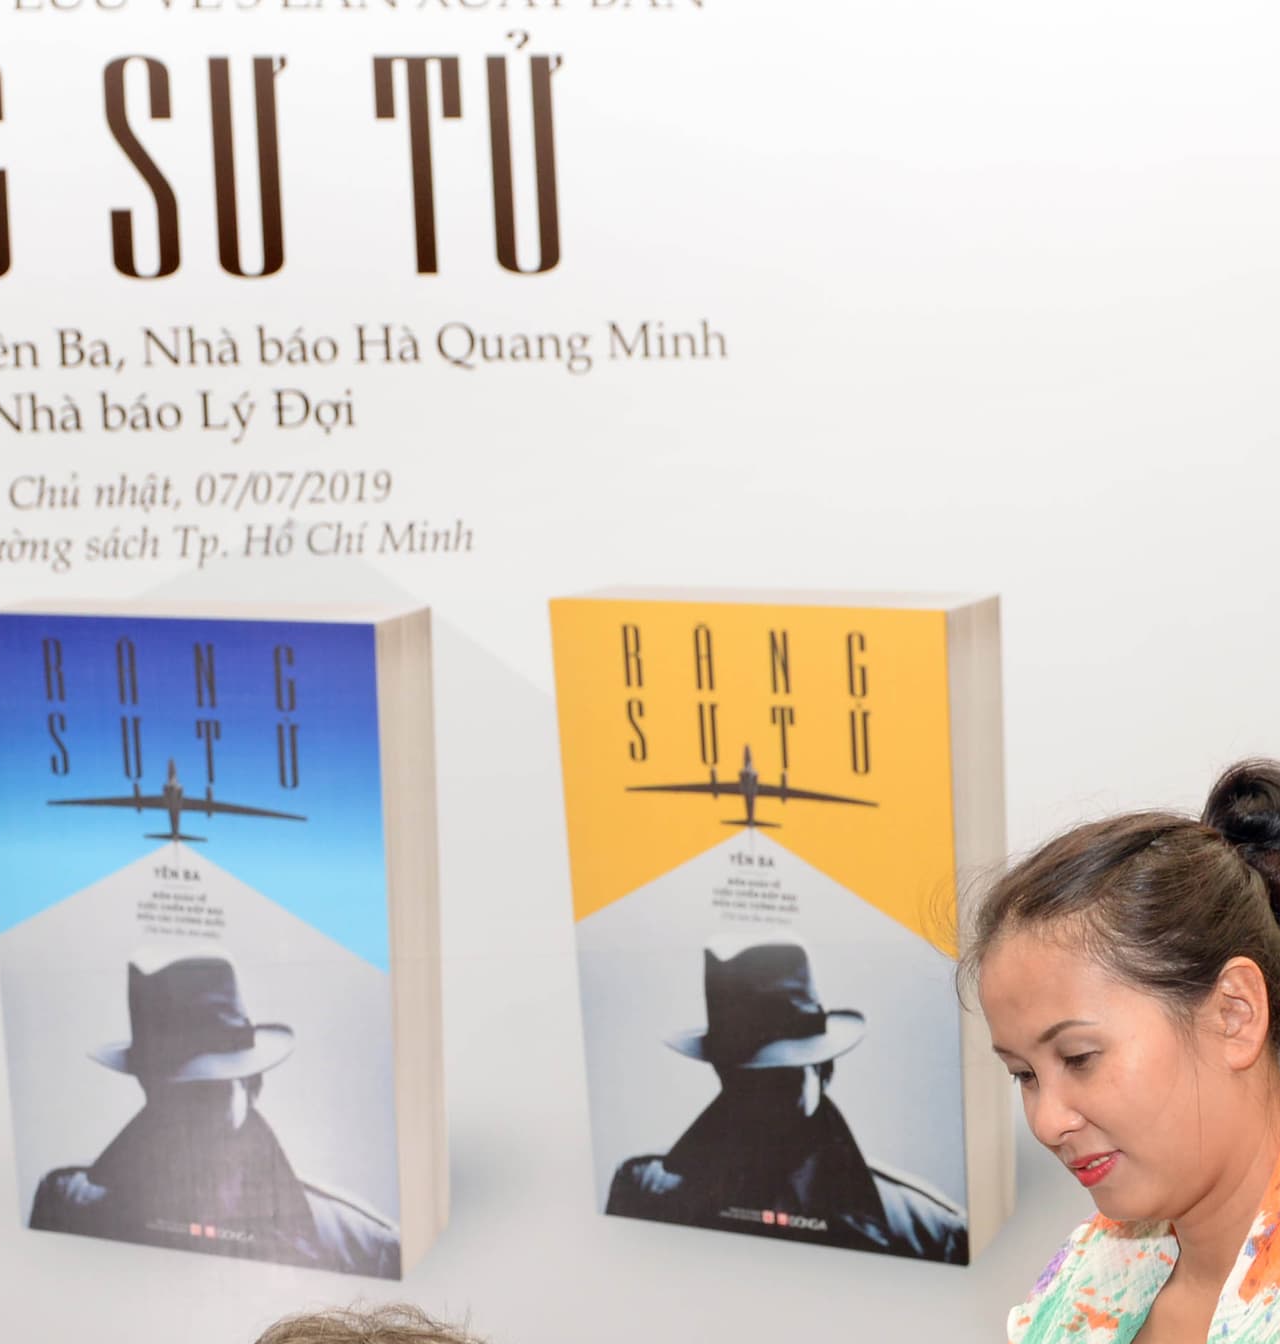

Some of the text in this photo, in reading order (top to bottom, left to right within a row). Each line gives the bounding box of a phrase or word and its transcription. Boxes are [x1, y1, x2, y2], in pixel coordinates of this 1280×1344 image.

[102, 55, 288, 281] SƯ
[372, 31, 563, 276] TỬ
[58, 329, 125, 373] Ba,
[143, 326, 241, 367] Nhà
[256, 325, 339, 366] báo
[356, 323, 421, 364] Hà
[435, 323, 593, 372] Quang
[608, 319, 727, 359] Minh
[99, 391, 183, 433] báo
[199, 389, 258, 443] Lý
[273, 389, 355, 435] Đợi
[8, 471, 80, 511] Chủ
[94, 472, 182, 514] nhật,
[194, 469, 393, 511] 07/07/2019
[84, 524, 160, 562] sách
[172, 524, 229, 570] Tp.
[242, 517, 295, 559] Hồ
[305, 520, 369, 557] Chí
[378, 518, 474, 554] Minh
